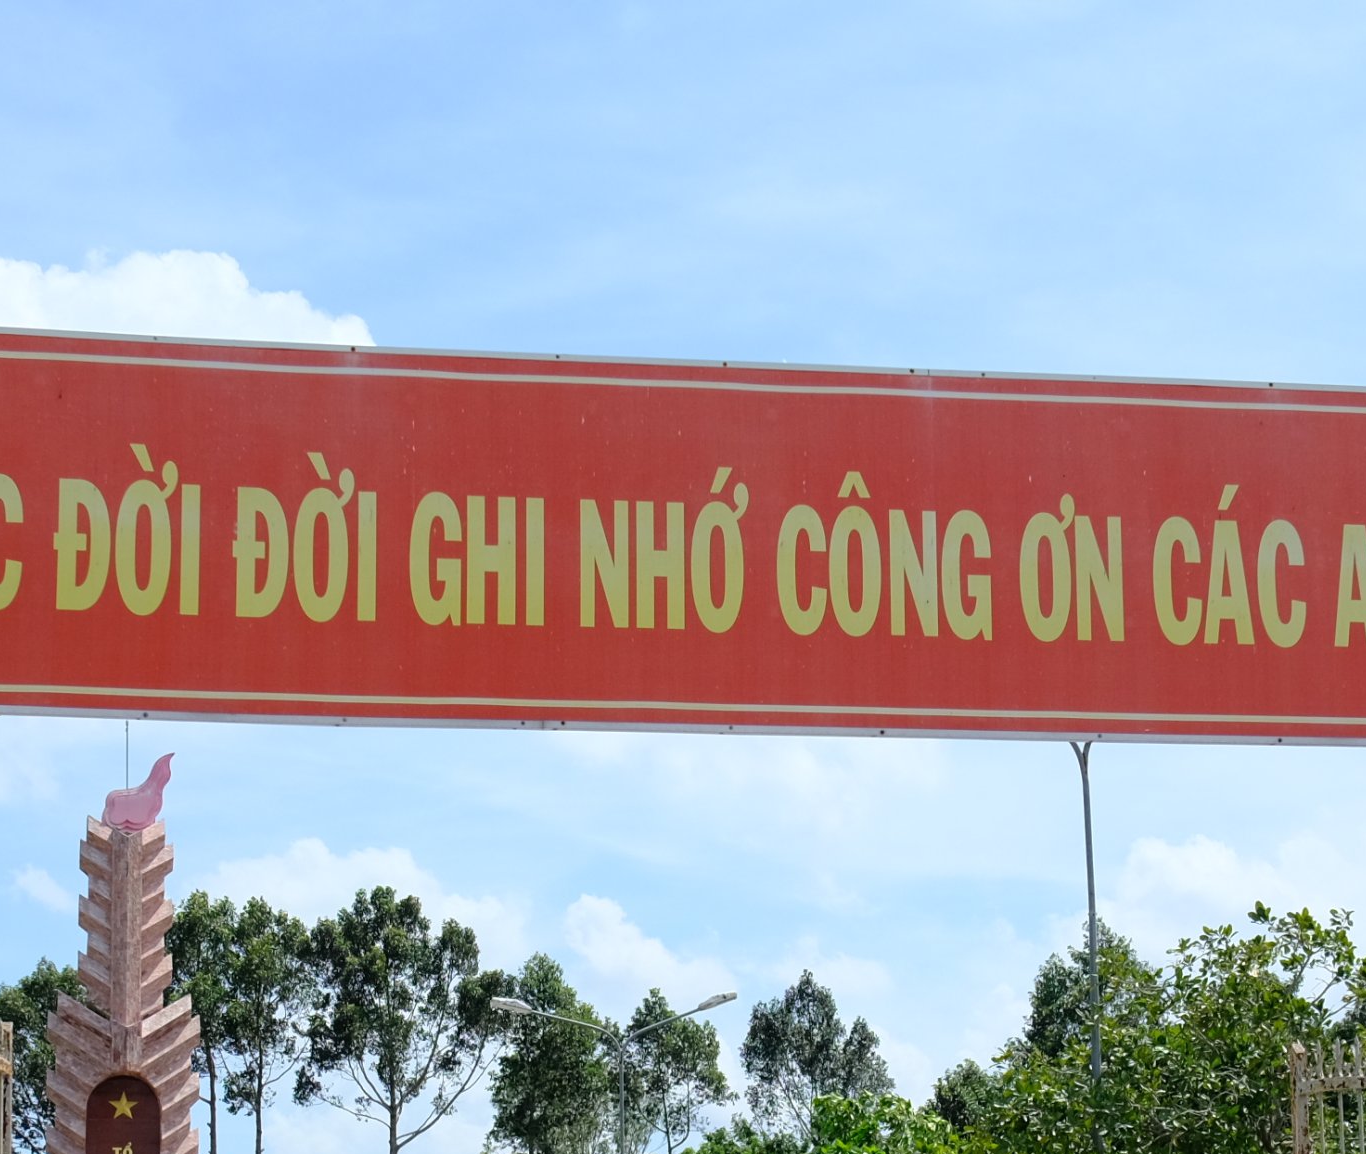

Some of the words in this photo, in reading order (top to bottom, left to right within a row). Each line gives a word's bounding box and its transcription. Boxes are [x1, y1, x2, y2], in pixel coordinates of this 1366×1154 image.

[53, 443, 201, 616] ĐỜI
[232, 452, 377, 623] ĐỜI
[409, 491, 545, 626] GHI
[579, 466, 749, 634] NHỚ
[776, 471, 993, 641] CÔNG
[1019, 493, 1125, 643] ƠN
[1152, 484, 1307, 648] CÁC
